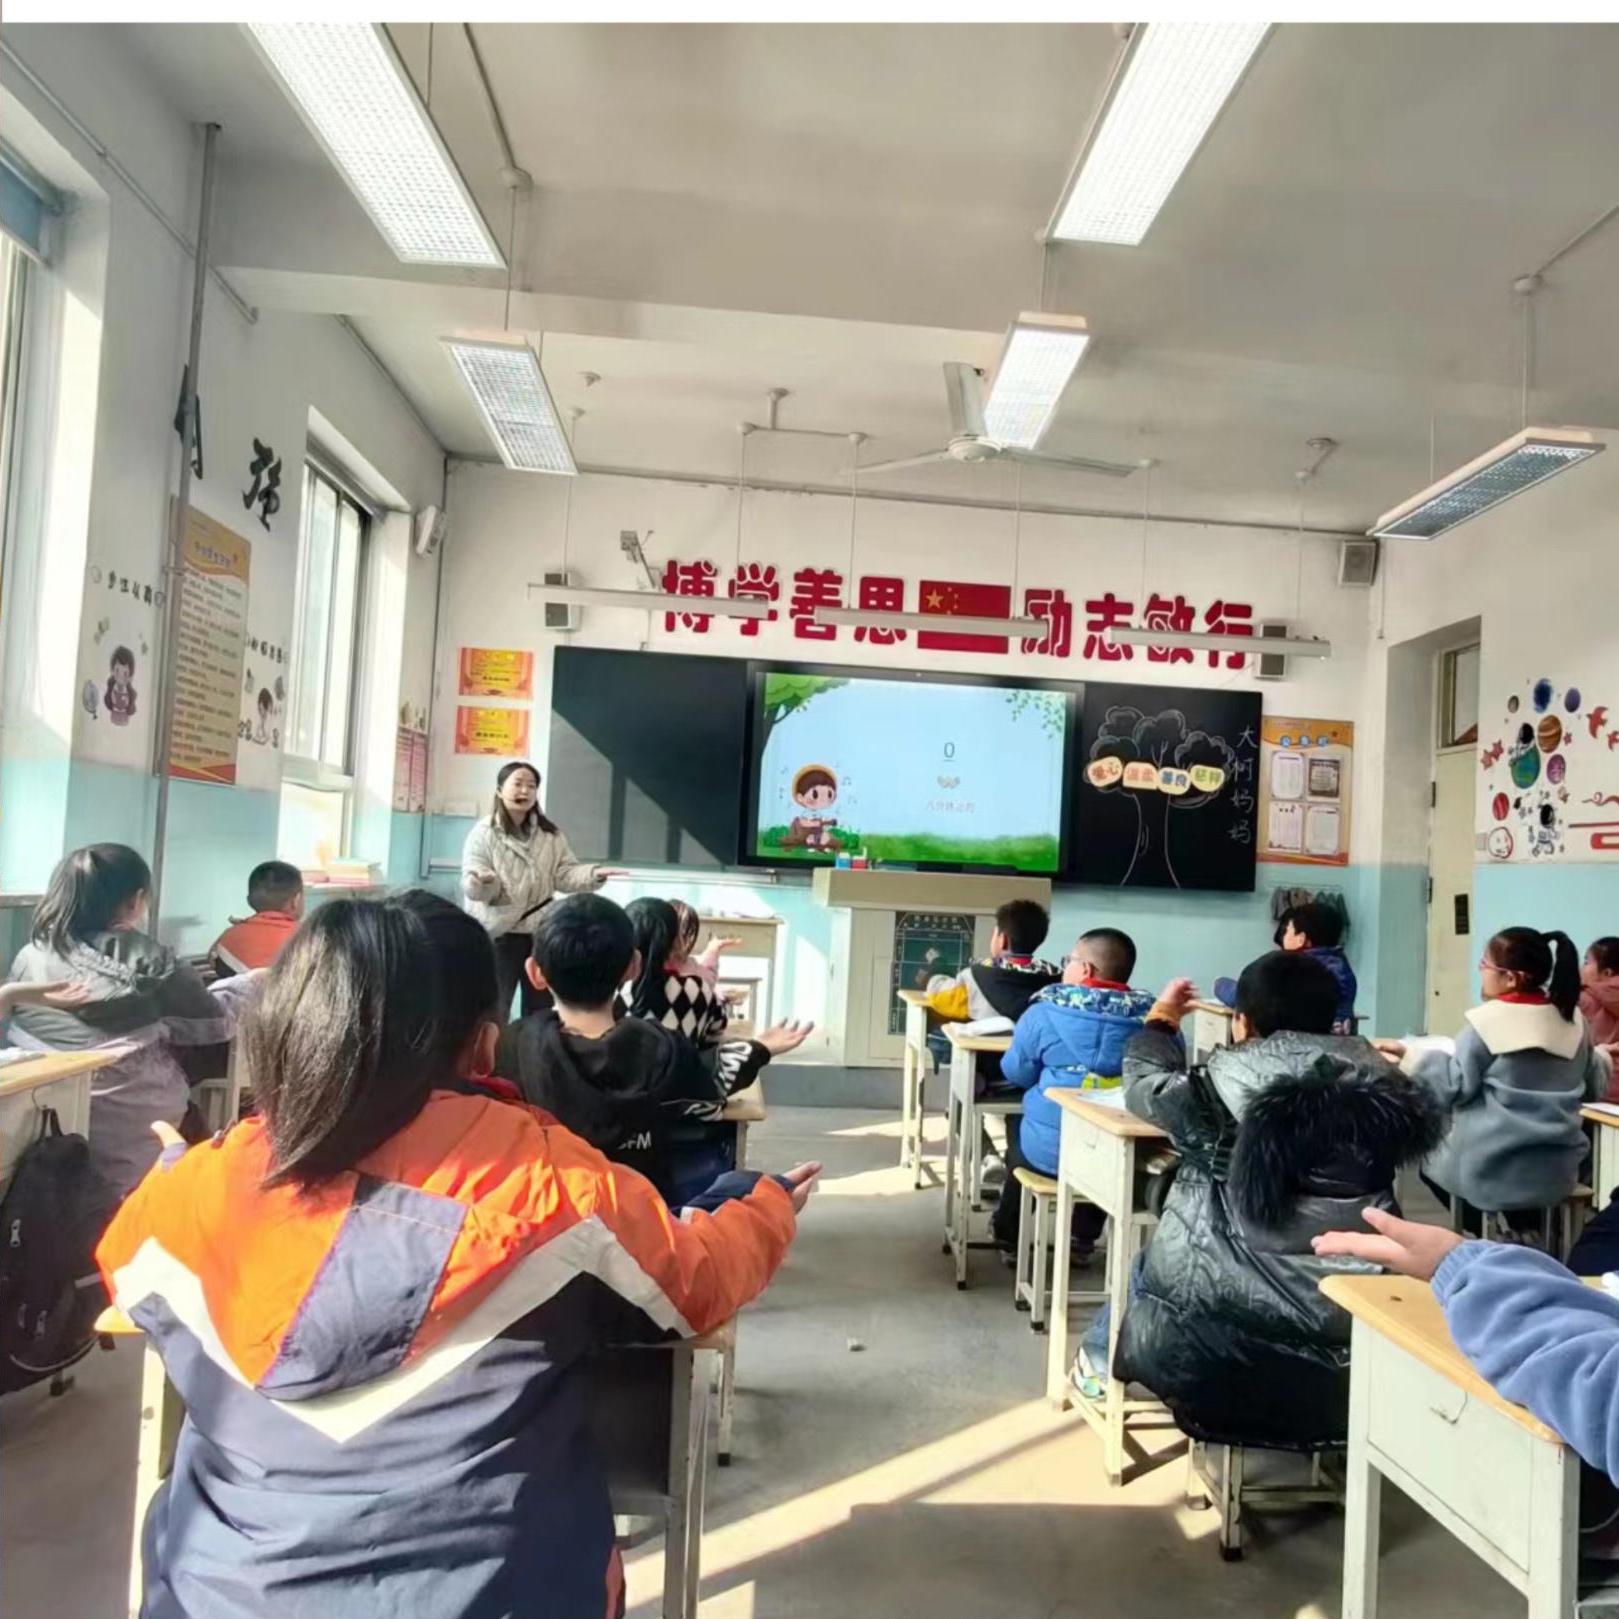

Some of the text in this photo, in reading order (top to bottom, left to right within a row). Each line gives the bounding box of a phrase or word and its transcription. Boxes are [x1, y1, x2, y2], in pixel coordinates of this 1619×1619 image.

[661, 559, 1254, 670] 博学善思 励志敏行
